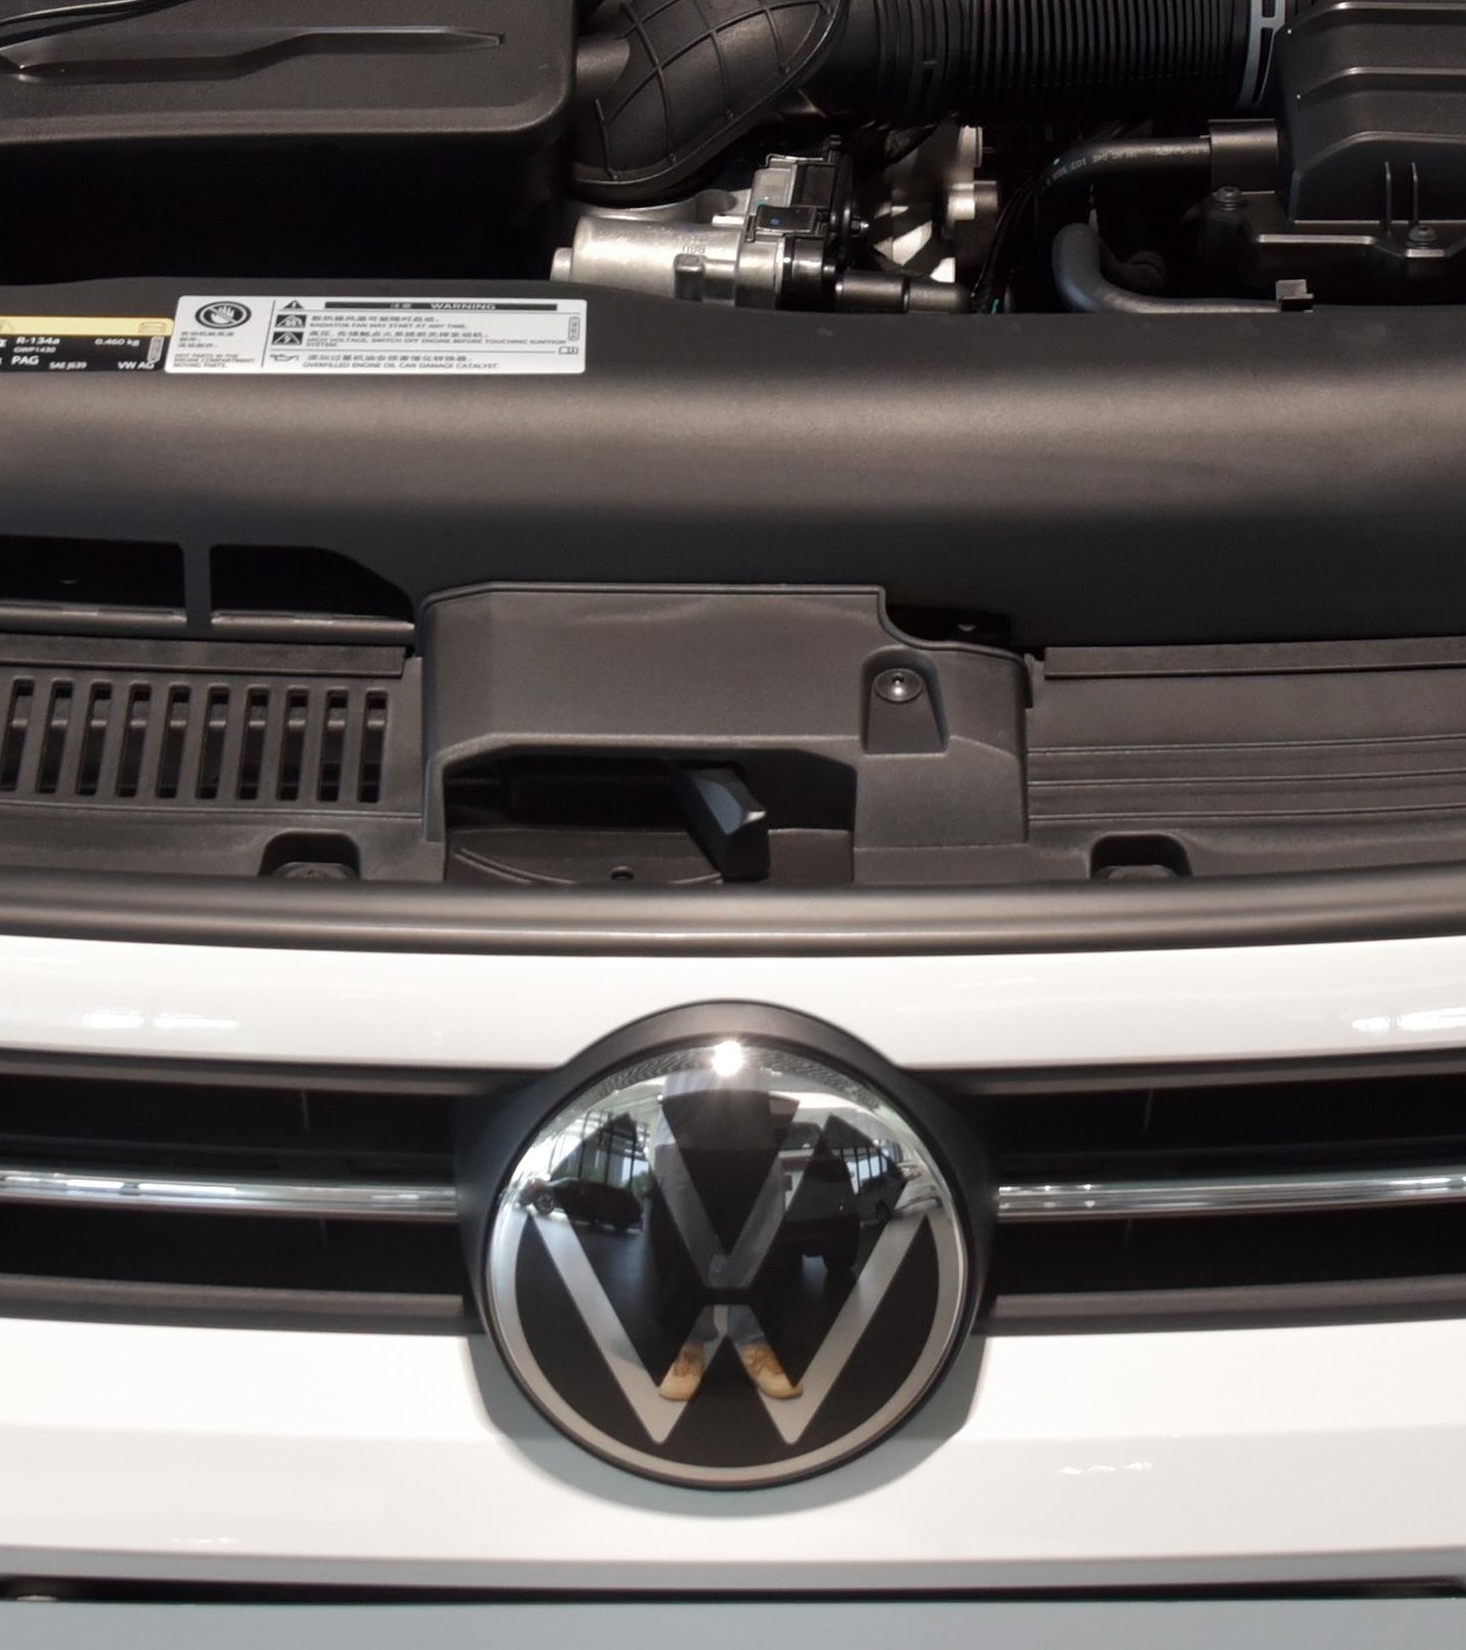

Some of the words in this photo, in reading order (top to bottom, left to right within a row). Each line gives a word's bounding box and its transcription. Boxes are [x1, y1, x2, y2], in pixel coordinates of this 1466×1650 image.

[431, 302, 496, 310] WARNING
[16, 336, 60, 346] R-134a
[126, 337, 140, 348] kg
[11, 355, 40, 366] PAG
[118, 360, 137, 370] VW
[137, 360, 155, 370] AG
